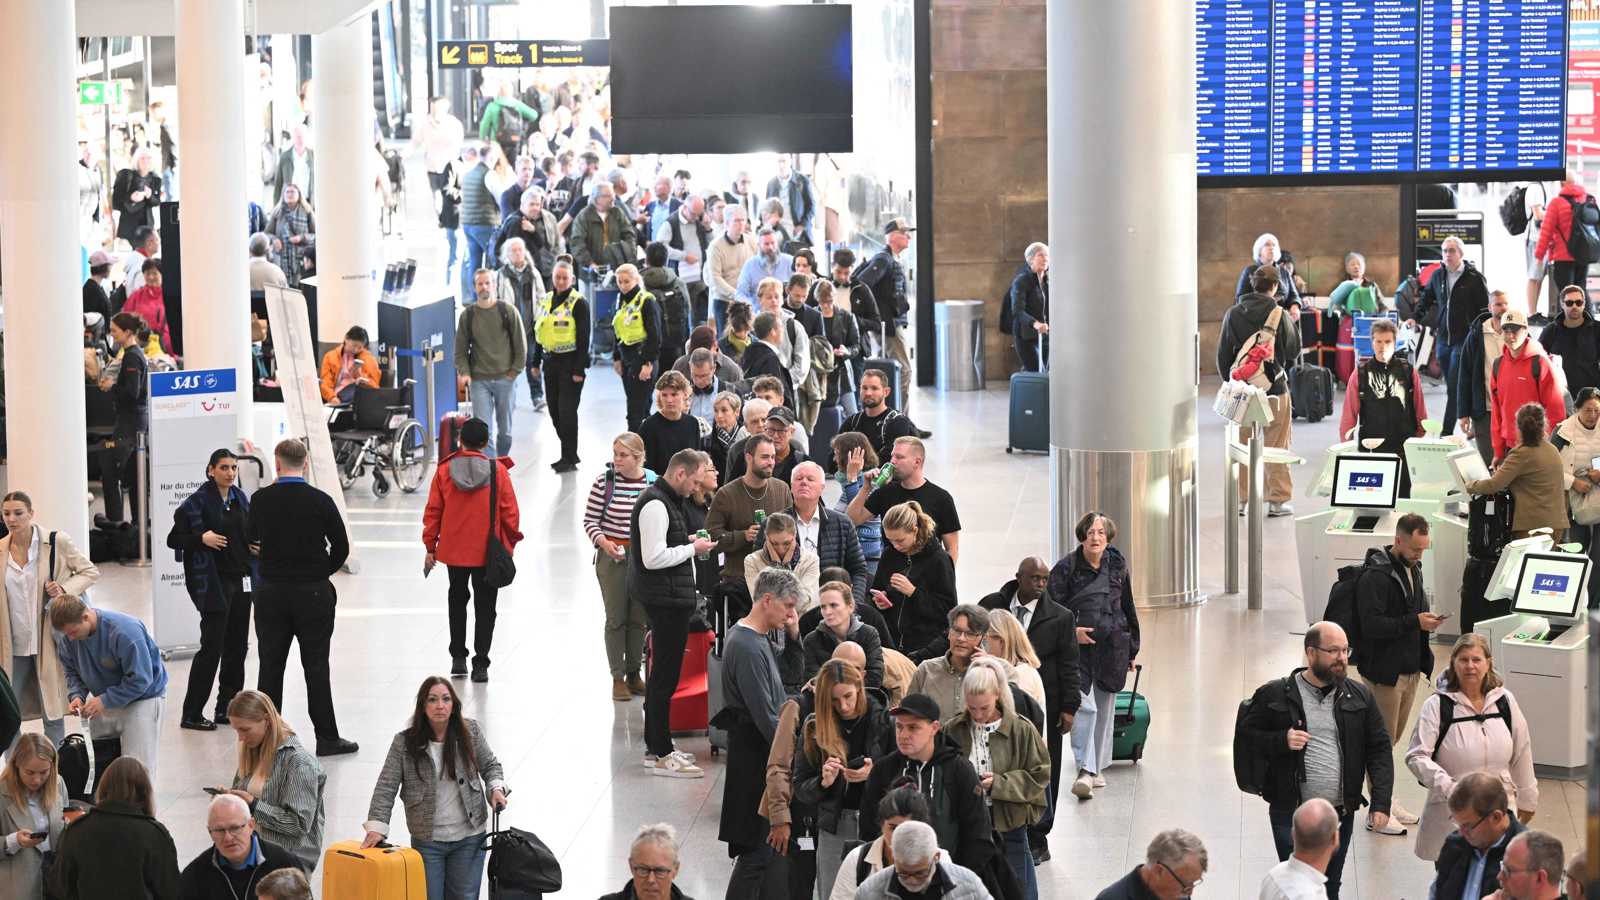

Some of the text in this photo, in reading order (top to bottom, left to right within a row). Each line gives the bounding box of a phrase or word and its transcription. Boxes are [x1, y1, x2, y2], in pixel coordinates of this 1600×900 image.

[494, 42, 519, 54] Spor
[528, 43, 538, 64] 1
[494, 53, 523, 64] Track
[171, 375, 201, 390] SAS
[1355, 475, 1370, 484] SAS
[161, 573, 185, 582] Alread
[1540, 578, 1555, 586] SAS
